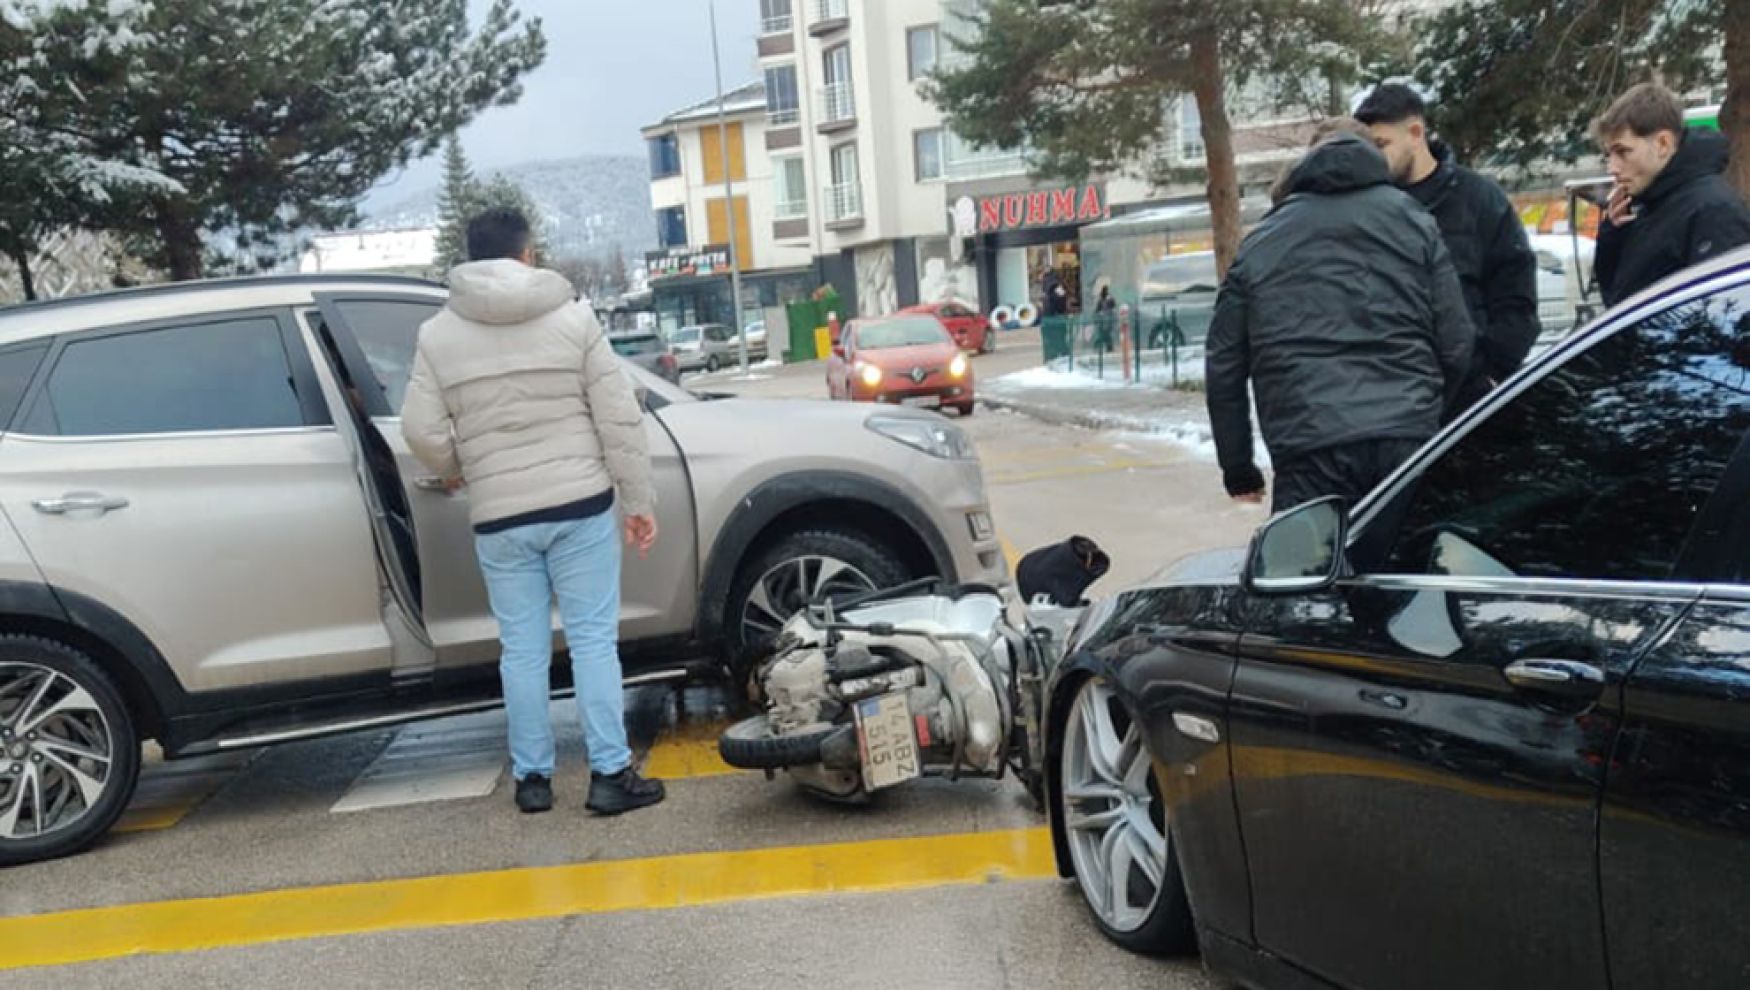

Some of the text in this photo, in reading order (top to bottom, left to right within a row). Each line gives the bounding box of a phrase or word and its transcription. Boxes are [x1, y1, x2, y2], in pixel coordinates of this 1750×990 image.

[980, 184, 1111, 231] NUHMA
[869, 724, 892, 765] 515
[886, 701, 915, 777] 14 ABZ
